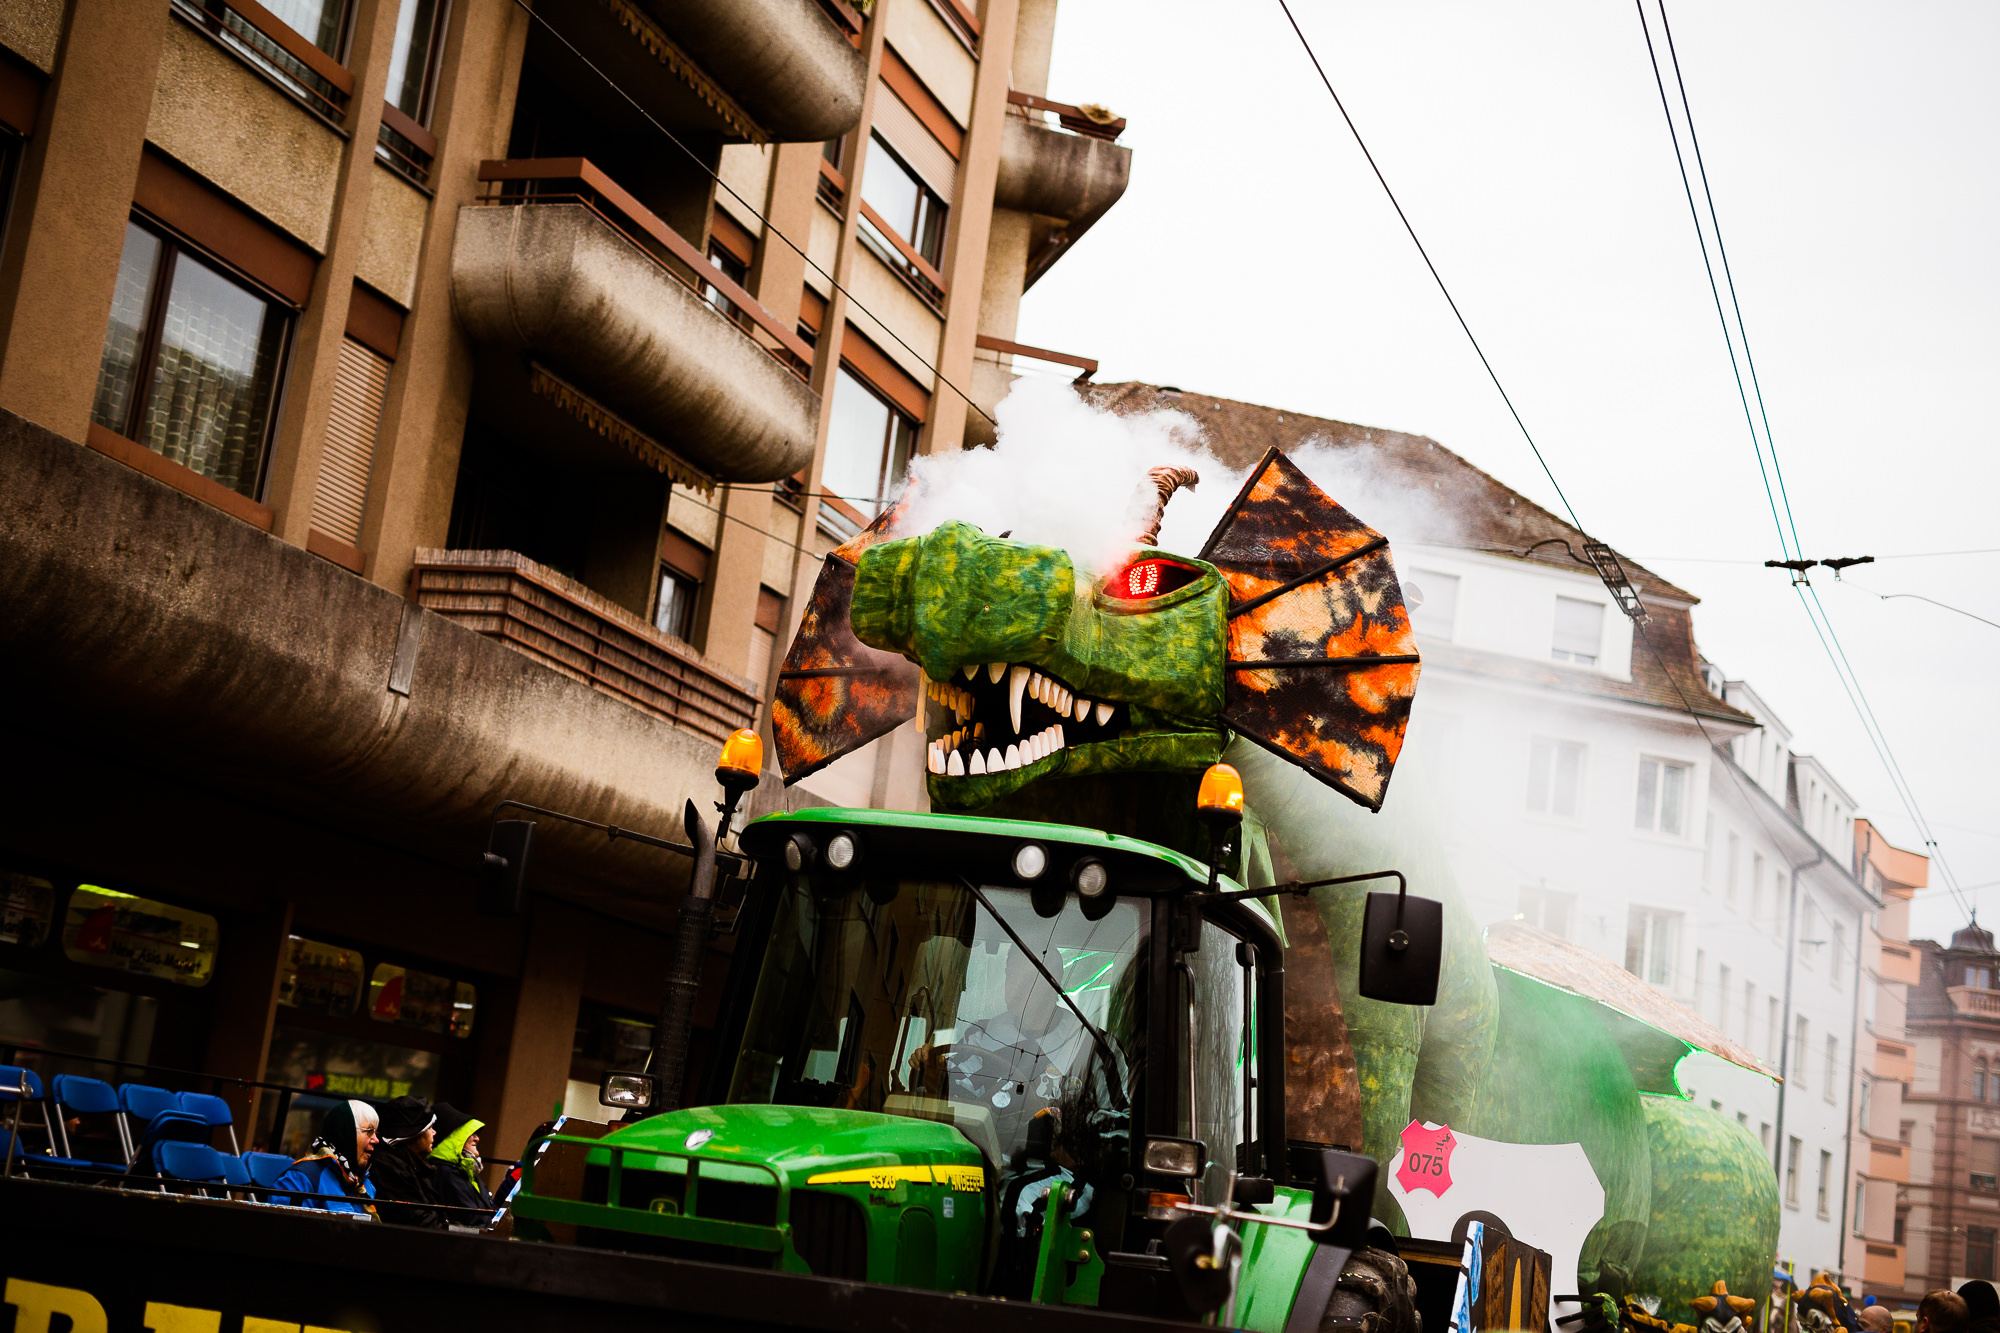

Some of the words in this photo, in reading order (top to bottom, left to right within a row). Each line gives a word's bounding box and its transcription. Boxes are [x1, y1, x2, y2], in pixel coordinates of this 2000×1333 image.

[111, 940, 134, 957] New
[138, 947, 161, 965] Asia
[1409, 1152, 1443, 1176] 075
